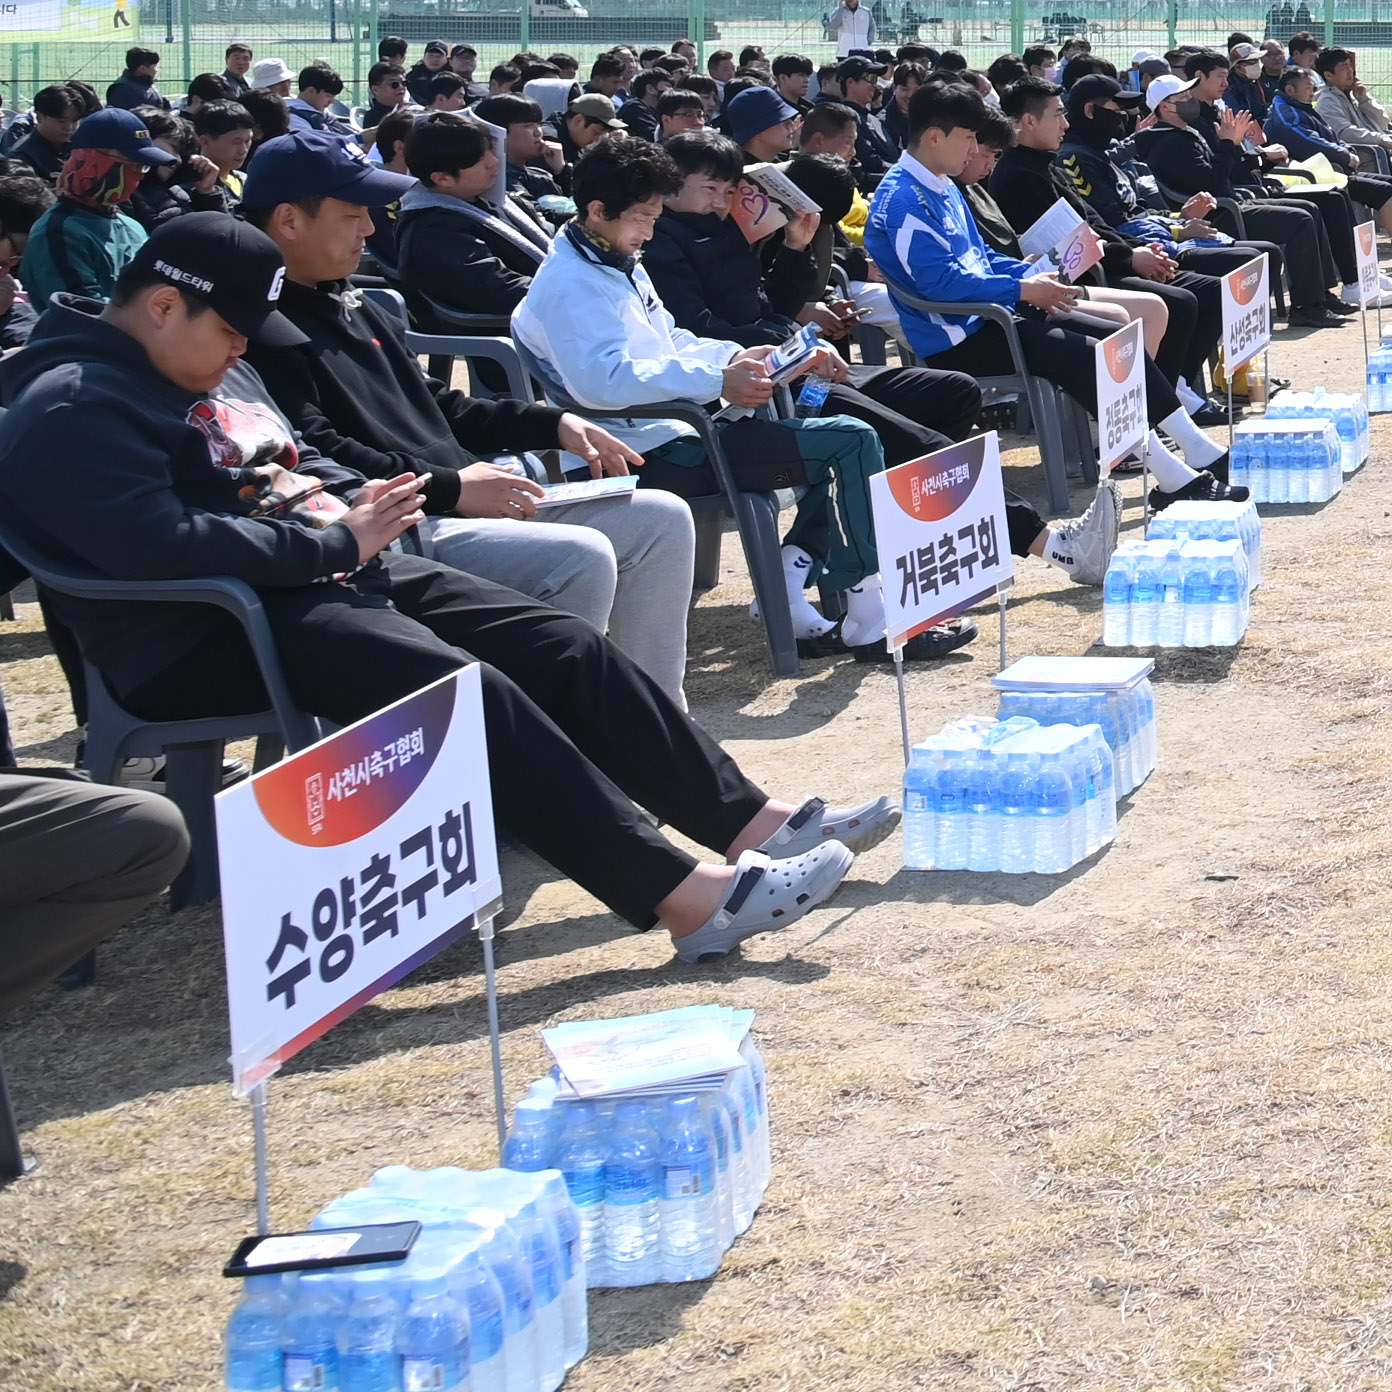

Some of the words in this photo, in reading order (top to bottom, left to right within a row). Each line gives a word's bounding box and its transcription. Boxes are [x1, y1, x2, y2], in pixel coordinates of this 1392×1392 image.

[153, 259, 215, 293] 롯데월드타워
[1230, 303, 1266, 357] 산성축구회
[1106, 382, 1143, 450] 정동축구회
[921, 462, 970, 497] 사천시축구협회
[895, 514, 999, 607] 거북축구회
[327, 727, 425, 803] 사천시축구협회
[265, 802, 477, 1009] 수양축구회
